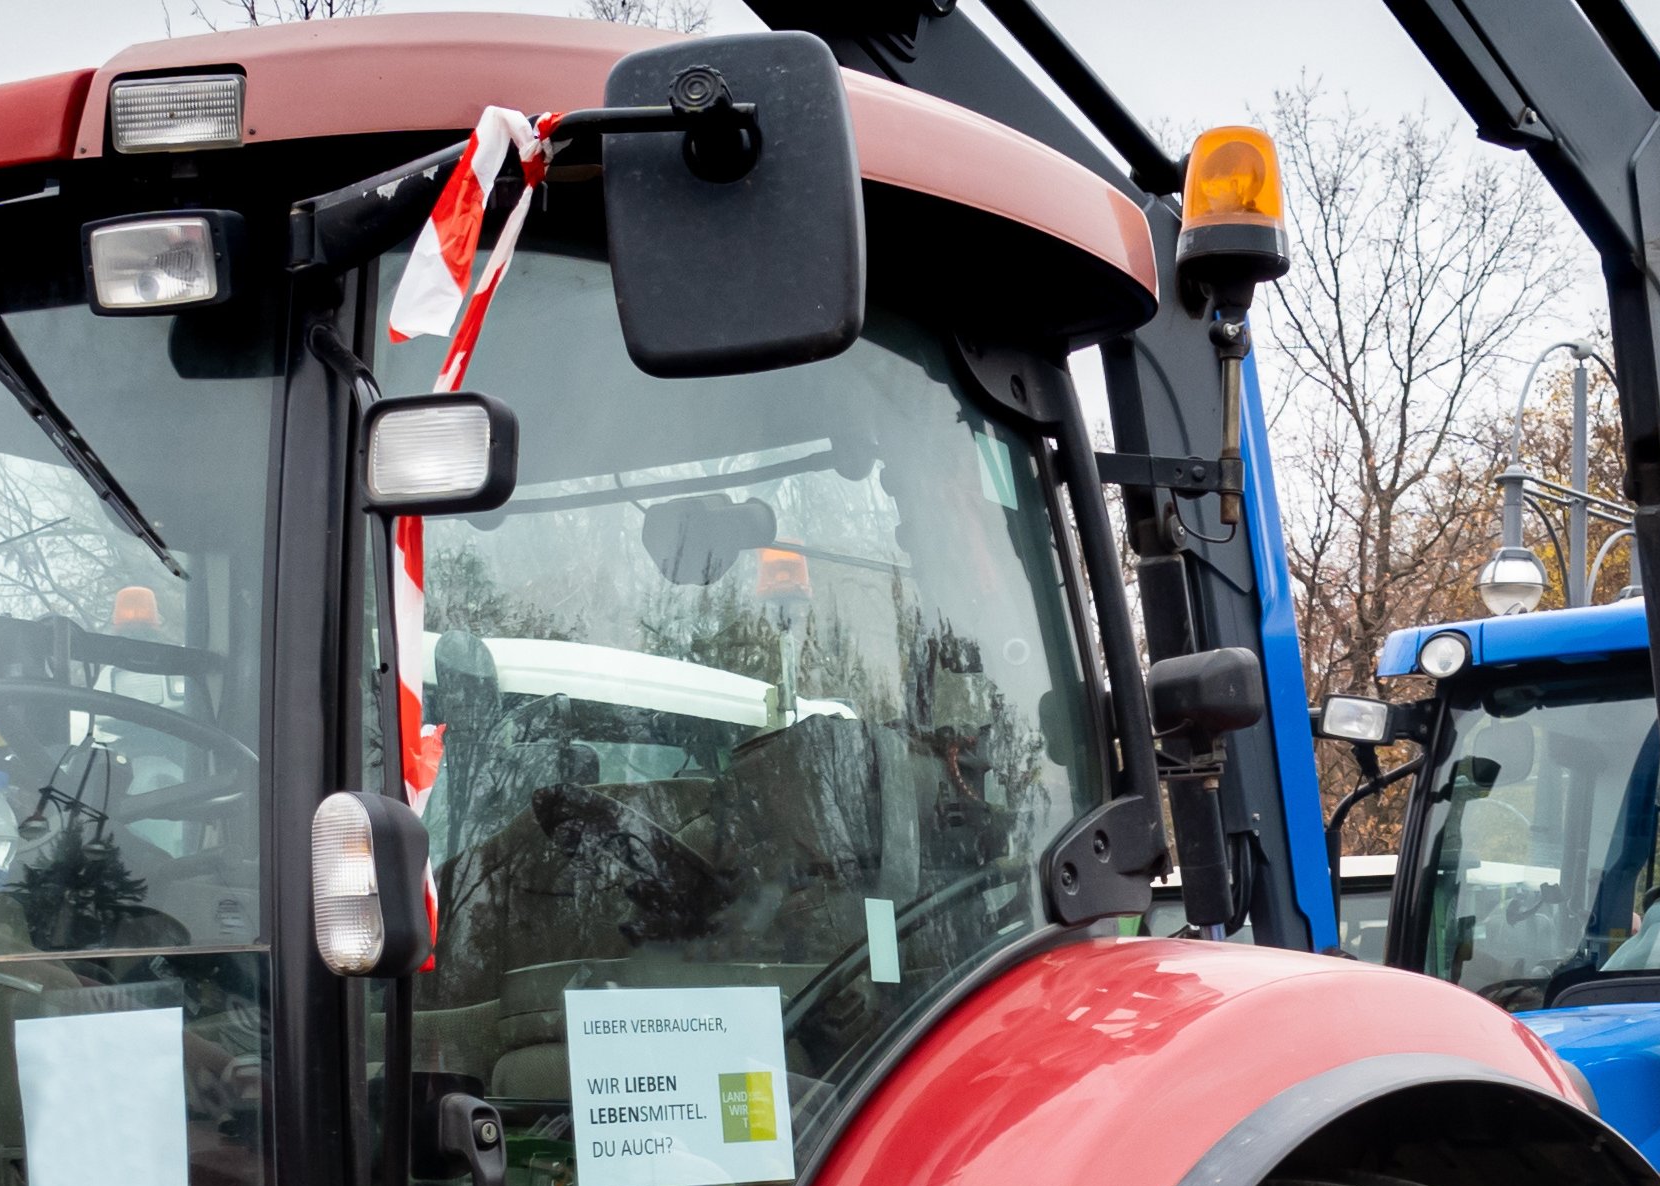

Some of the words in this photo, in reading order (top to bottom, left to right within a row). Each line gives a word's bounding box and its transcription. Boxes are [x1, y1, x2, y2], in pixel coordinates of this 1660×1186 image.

[583, 1019, 628, 1035] LIEBER
[631, 1017, 727, 1034] VERBRAUCHER,
[587, 1078, 620, 1095] WIR
[625, 1075, 677, 1093] LIEBEN
[722, 1091, 748, 1103] LAND
[590, 1103, 707, 1124] LEBENSMITTEL.
[728, 1104, 748, 1116] WIR
[592, 1140, 616, 1158] DU
[621, 1136, 673, 1157] AUCH?
